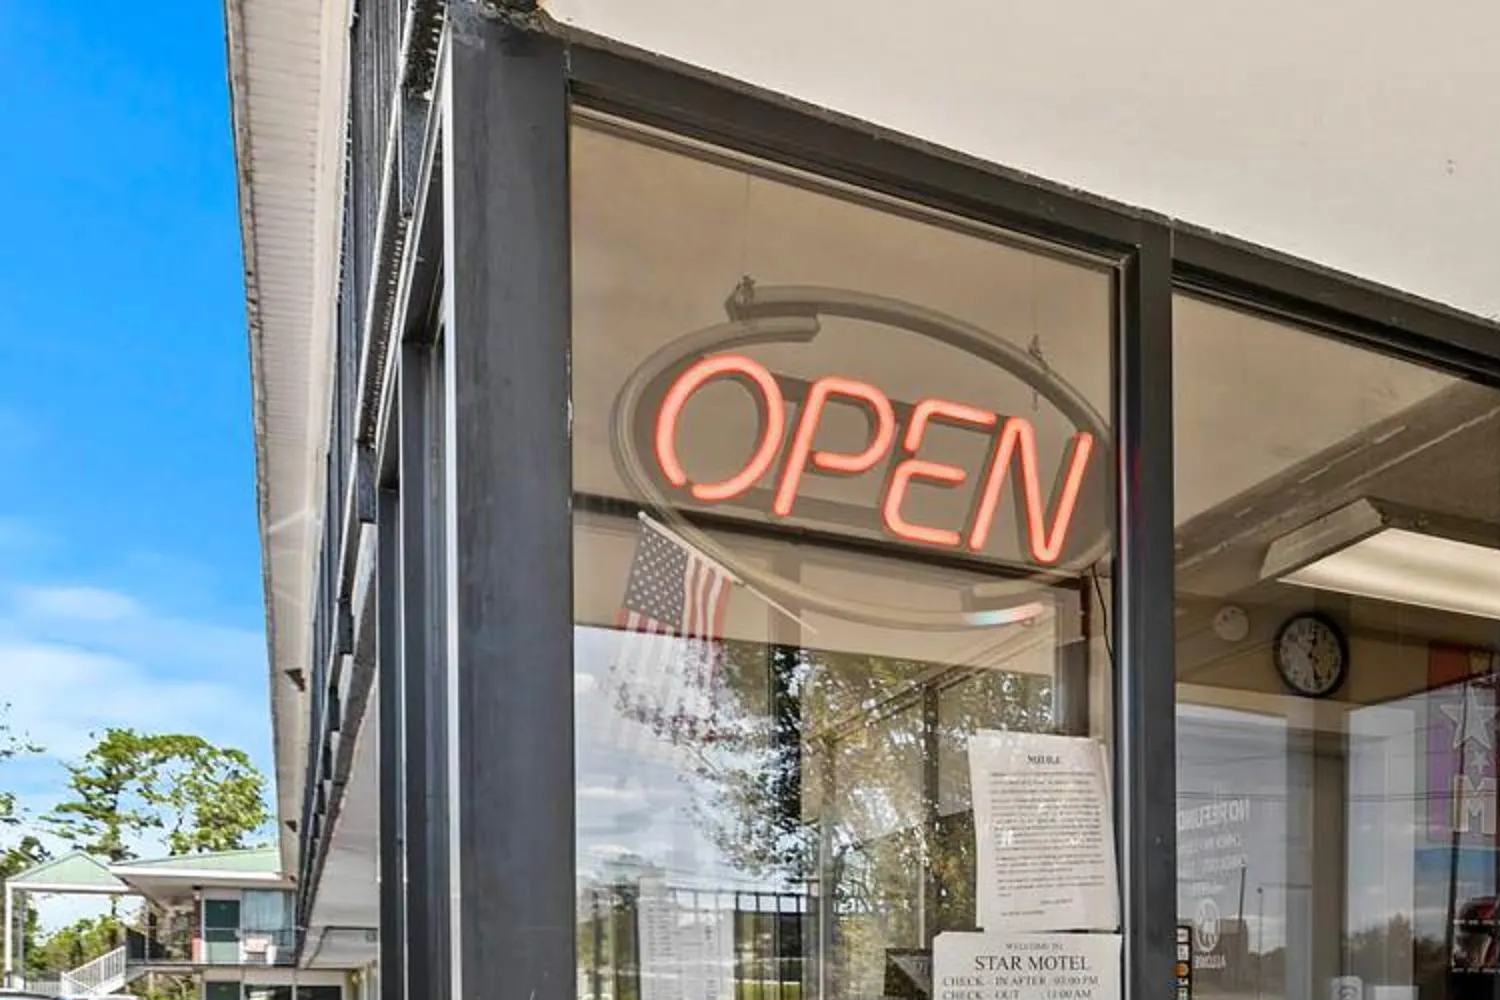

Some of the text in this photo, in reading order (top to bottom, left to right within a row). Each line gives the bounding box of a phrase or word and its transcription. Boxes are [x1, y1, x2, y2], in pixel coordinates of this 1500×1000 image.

[653, 352, 1095, 564] OPEN
[974, 955, 1091, 971] STAR MOTEL
